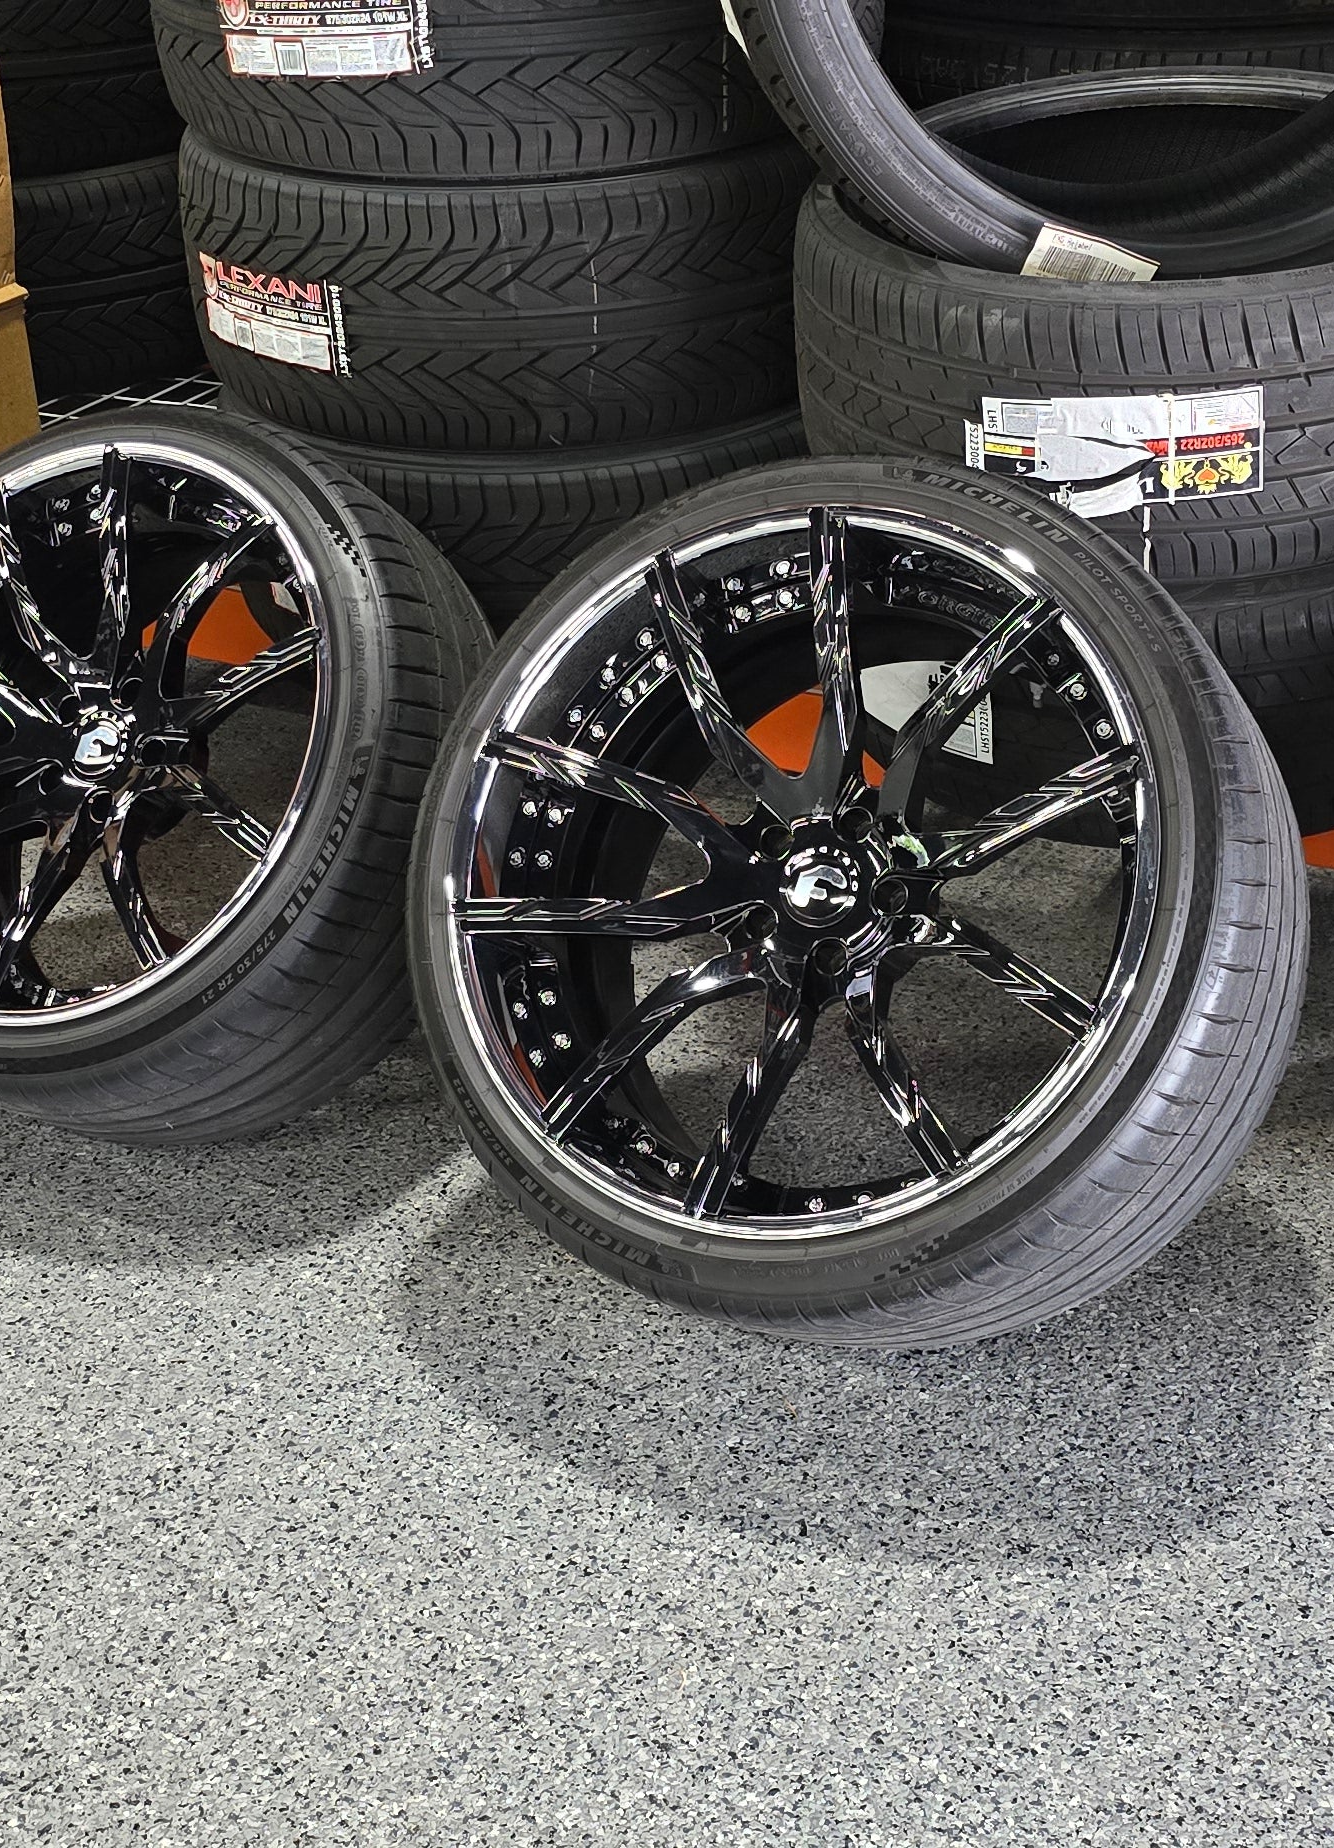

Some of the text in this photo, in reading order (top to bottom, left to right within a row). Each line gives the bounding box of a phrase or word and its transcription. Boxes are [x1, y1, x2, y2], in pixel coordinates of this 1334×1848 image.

[216, 261, 322, 304] LEXANI
[220, 281, 323, 311] PERFORMANCE TIRE
[987, 409, 998, 432] LHS
[1181, 432, 1244, 451] 265/30ZR22
[924, 474, 1069, 543] MICHELIN
[1073, 551, 1111, 585] PILOT
[1113, 587, 1149, 630] SPORT
[199, 789, 359, 1005] MICHELIN 275/30 ZR 21
[452, 1077, 652, 1267] MICHELIN 335/25 ZR 22
[1016, 1167, 1036, 1186] MADE
[976, 1189, 1006, 1212] FRANCE
